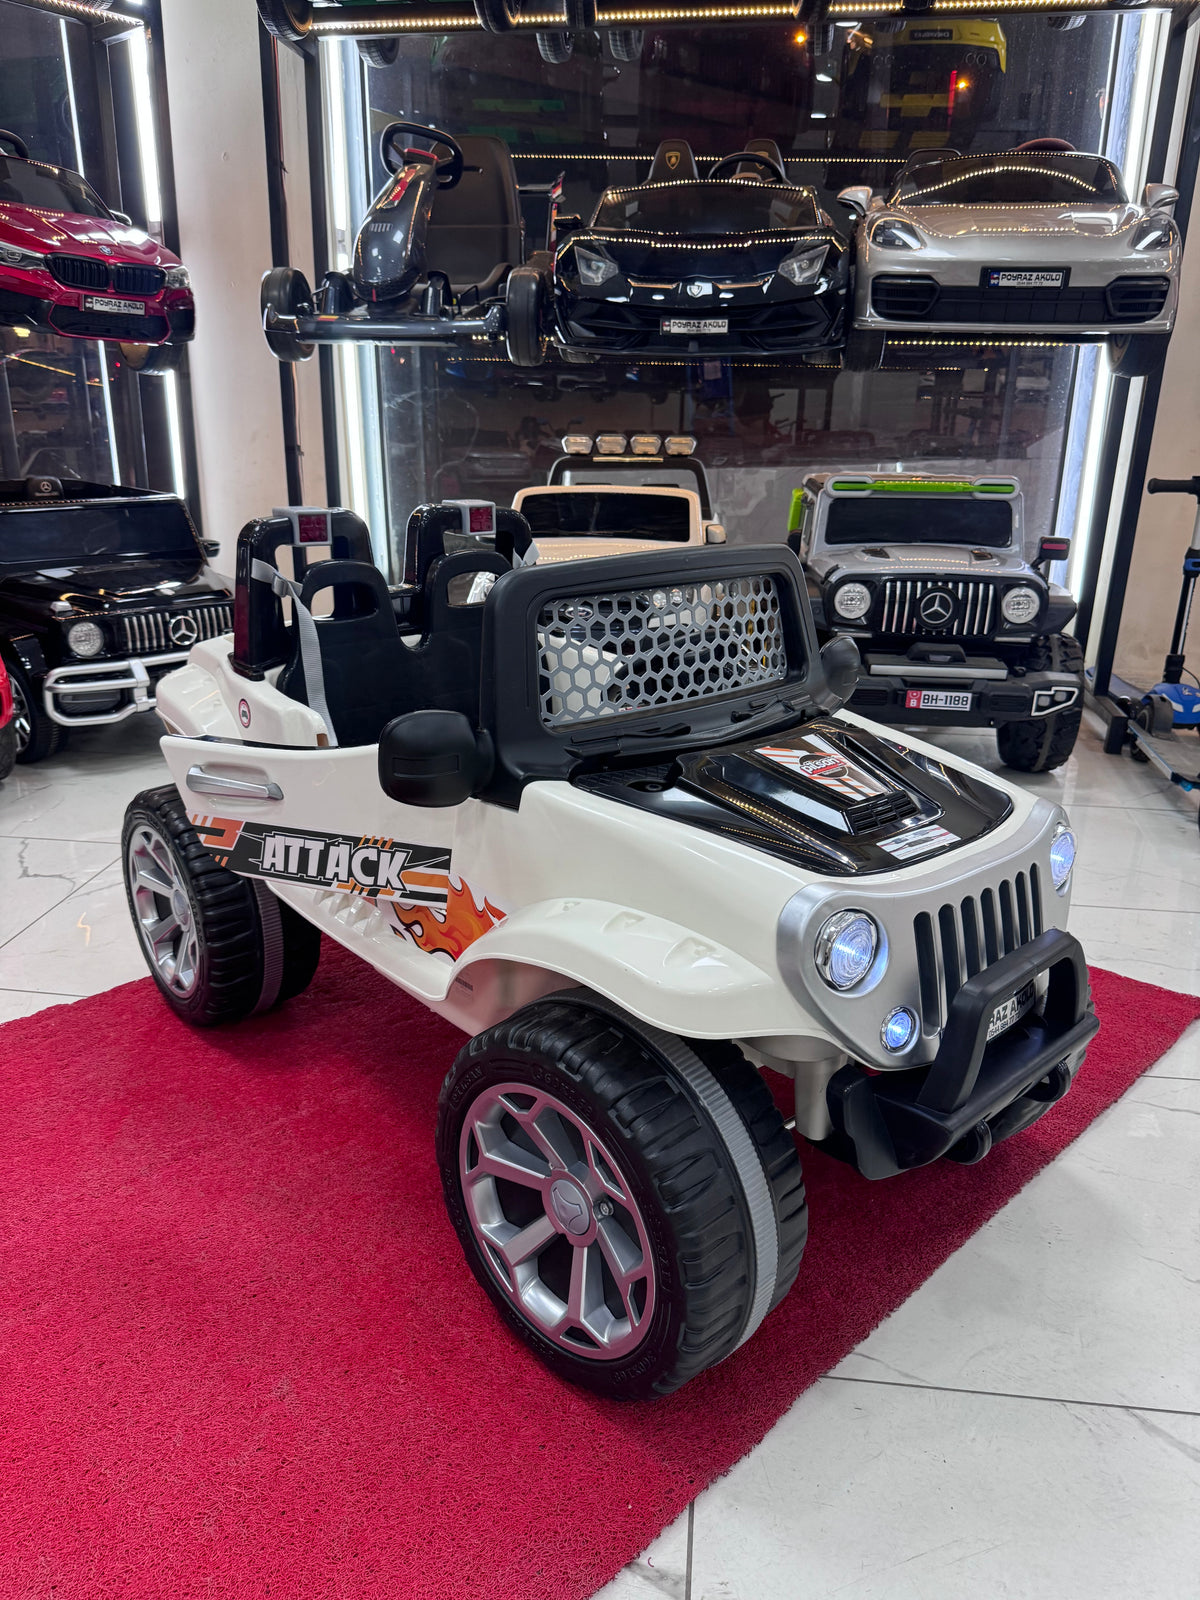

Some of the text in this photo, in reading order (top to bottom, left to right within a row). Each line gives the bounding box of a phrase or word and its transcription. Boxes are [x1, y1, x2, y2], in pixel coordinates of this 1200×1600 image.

[1001, 273, 1033, 281] POYRAZ
[94, 298, 122, 308] POYRAZ
[672, 321, 702, 329] POYRAZ
[922, 693, 969, 706] BH-1188
[800, 757, 841, 774] pilsan
[262, 833, 408, 890] ATTACK
